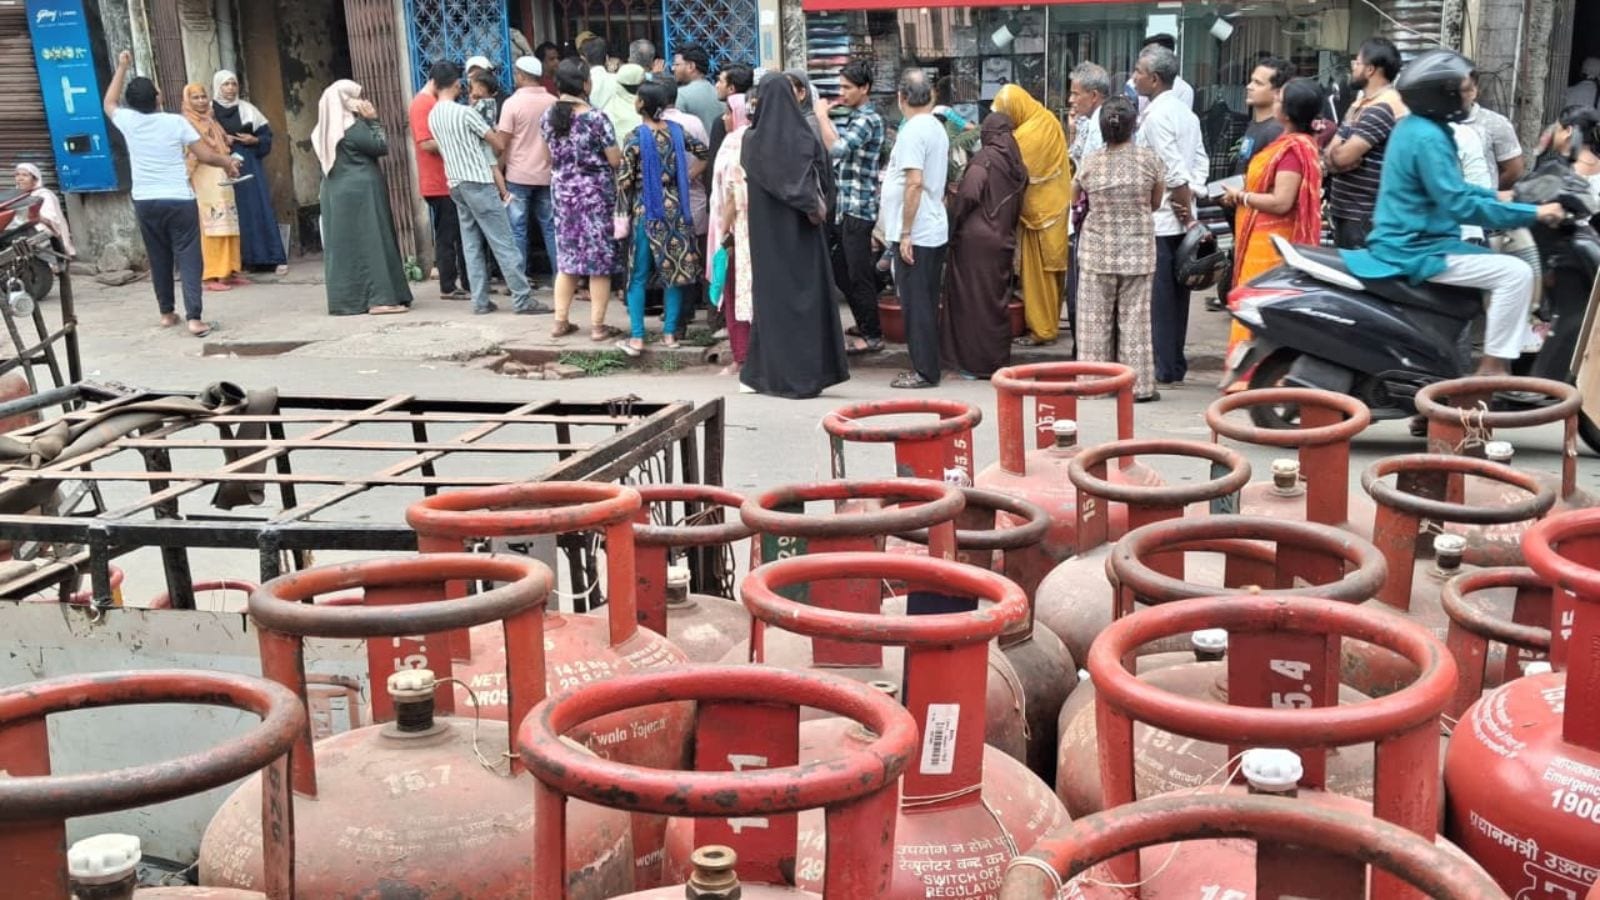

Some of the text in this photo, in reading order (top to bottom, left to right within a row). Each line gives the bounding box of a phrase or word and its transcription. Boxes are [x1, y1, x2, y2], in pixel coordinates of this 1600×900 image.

[1082, 492, 1096, 523] 15
[392, 634, 428, 672] 5.7
[464, 689, 510, 707] GROS
[1270, 659, 1313, 711] 5.4
[1543, 767, 1600, 799] Emergenc
[924, 865, 1001, 886] SWITCH OFF
[926, 876, 1003, 898] REGULATOR
